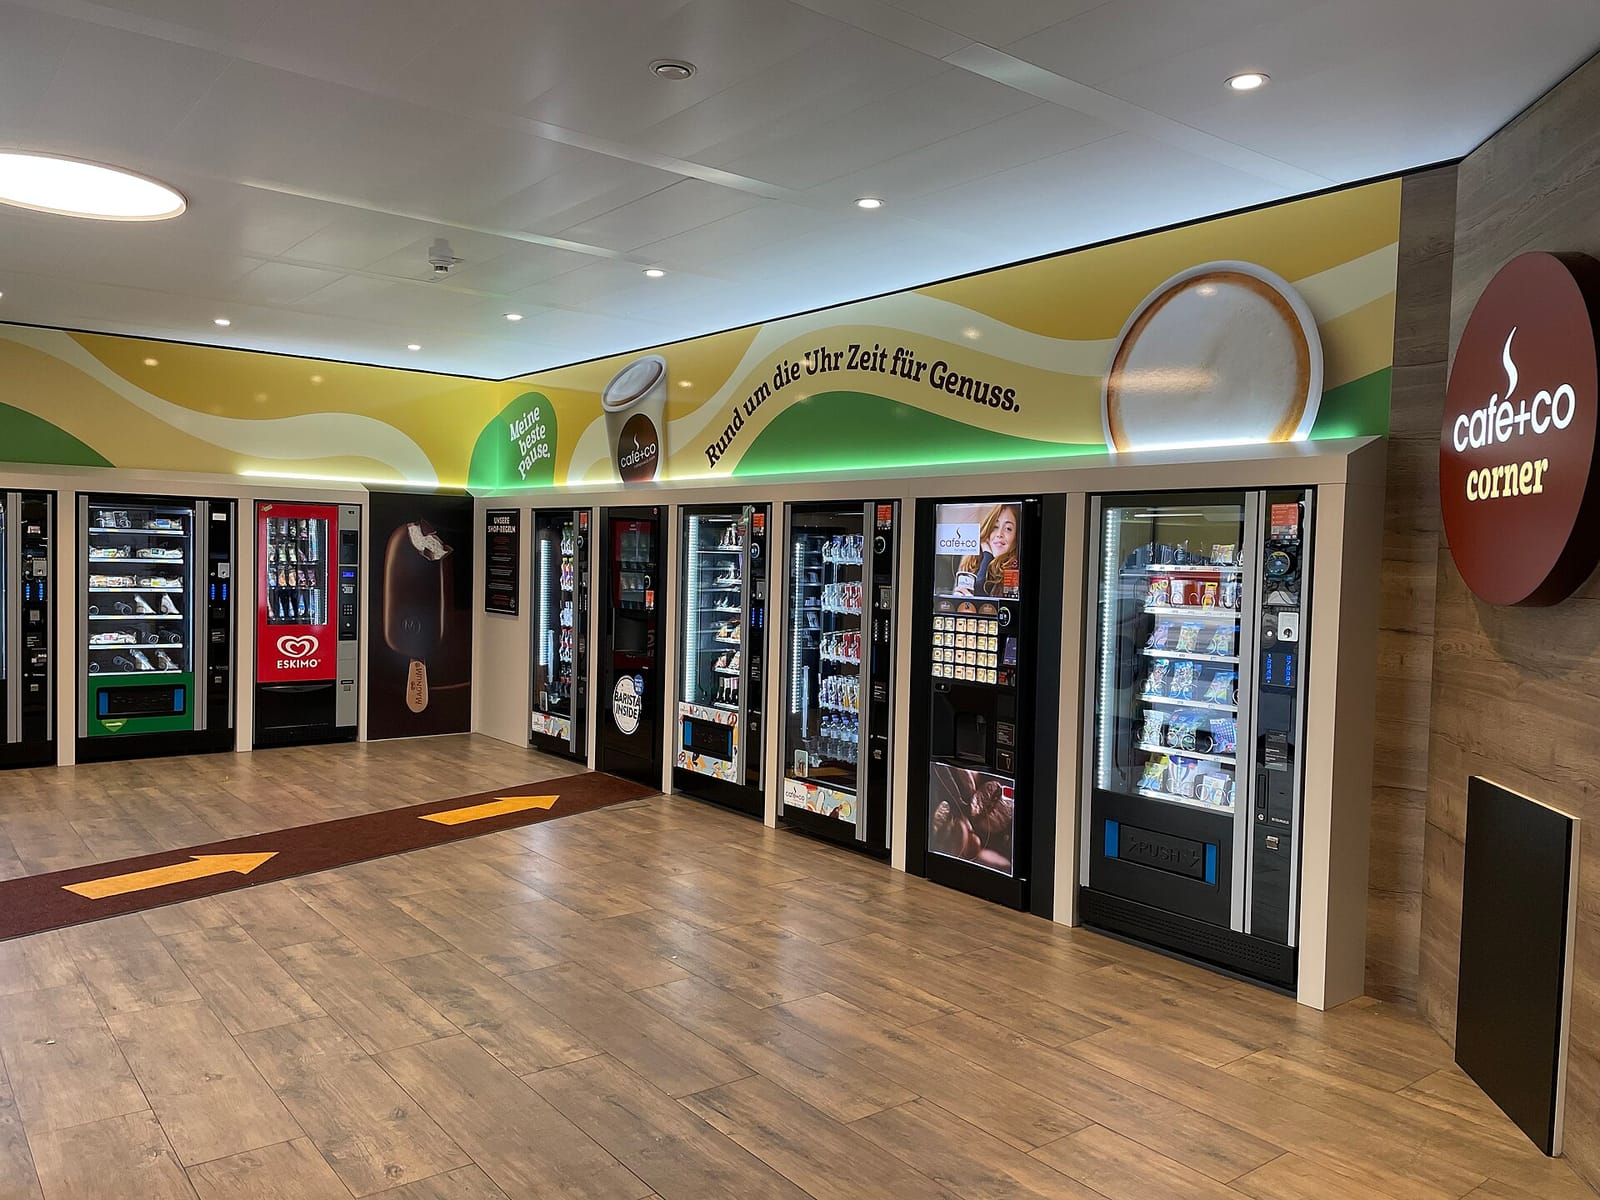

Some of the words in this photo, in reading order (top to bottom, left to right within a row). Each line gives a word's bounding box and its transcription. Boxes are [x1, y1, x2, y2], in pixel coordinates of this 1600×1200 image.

[705, 406, 745, 468] Rund
[743, 382, 771, 417] um
[773, 360, 801, 391] die
[804, 347, 844, 376] Uhr
[846, 343, 888, 373] Zeit
[889, 347, 927, 382] für
[929, 360, 1020, 413] Genuss.
[509, 406, 540, 442] Meine
[518, 424, 546, 457] beste
[1466, 458, 1549, 501] corner
[276, 659, 318, 669] ESKIMO
[415, 668, 423, 705] MAGNUM
[615, 691, 641, 707] BARISTA
[616, 703, 639, 720] INSIDE
[1139, 841, 1181, 863] PUSH
